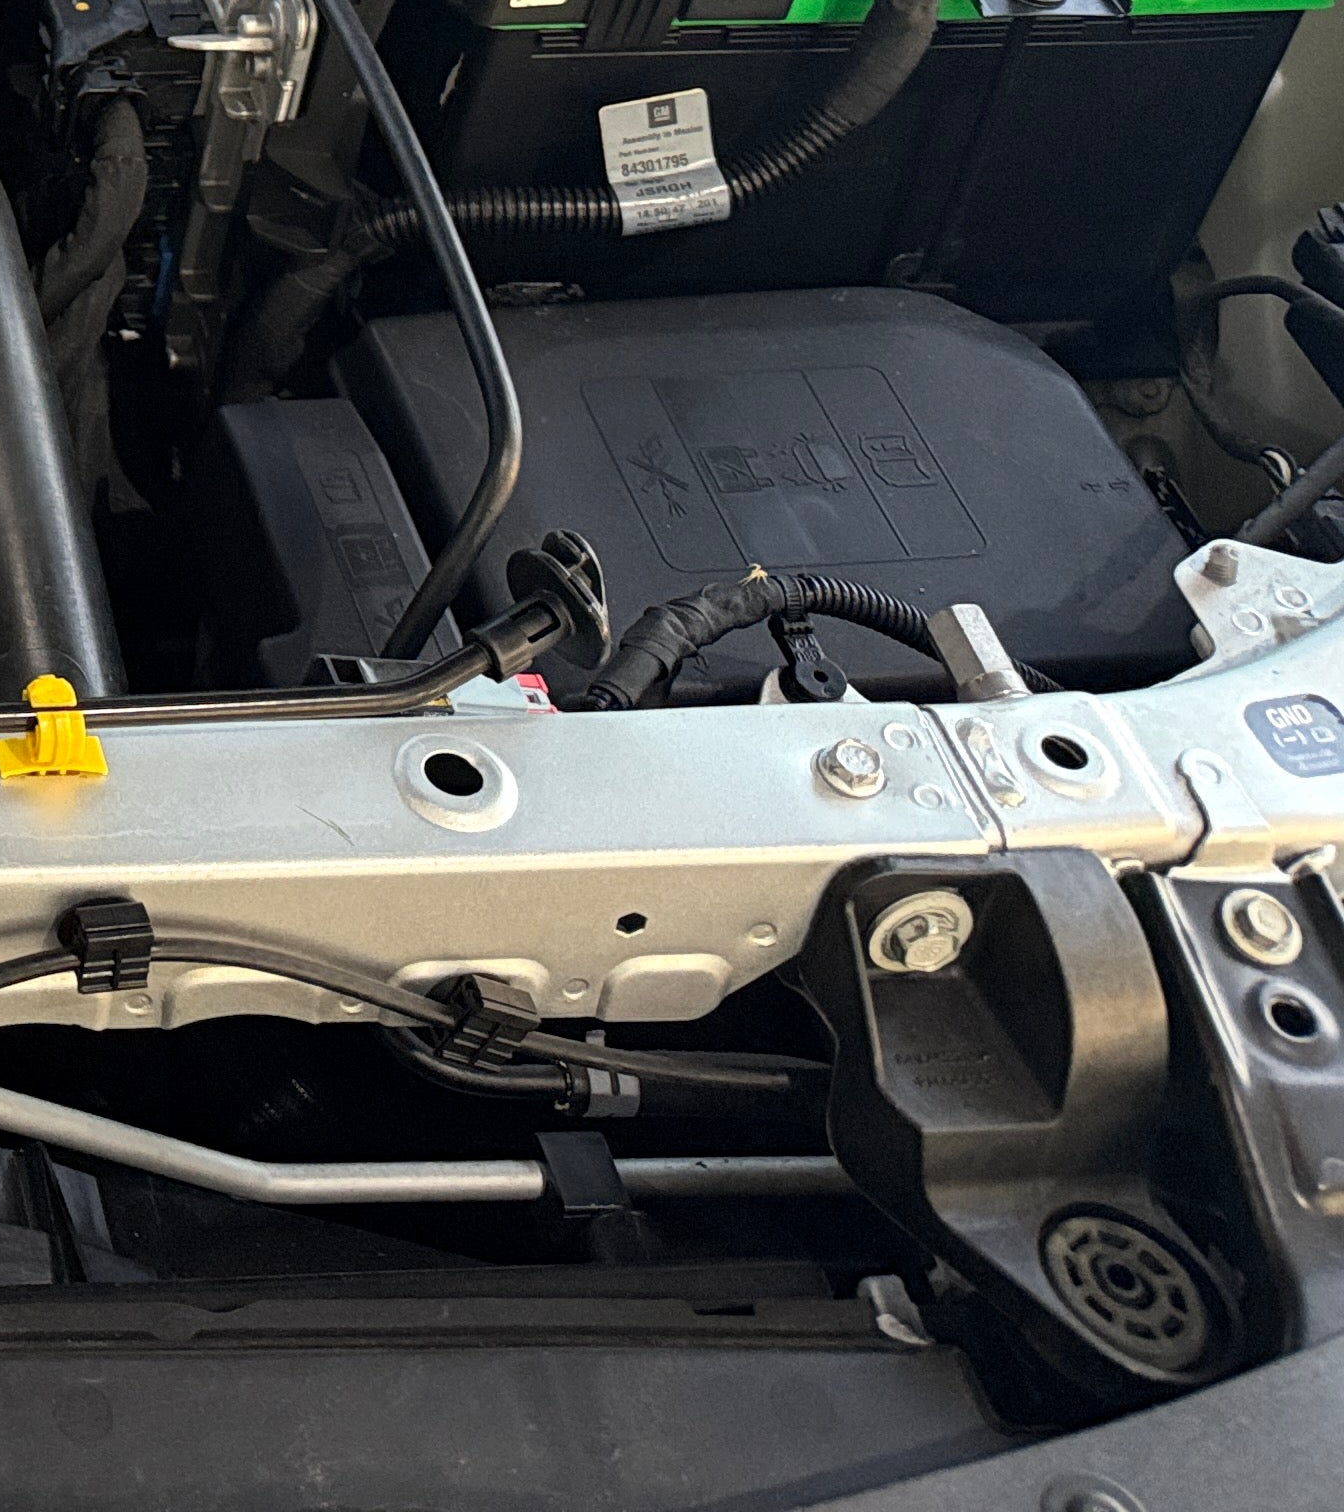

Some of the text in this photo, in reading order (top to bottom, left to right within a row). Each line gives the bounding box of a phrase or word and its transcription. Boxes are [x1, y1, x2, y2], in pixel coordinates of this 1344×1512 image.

[653, 104, 671, 118] GM
[621, 153, 689, 177] 84301795
[1265, 703, 1313, 729] GND
